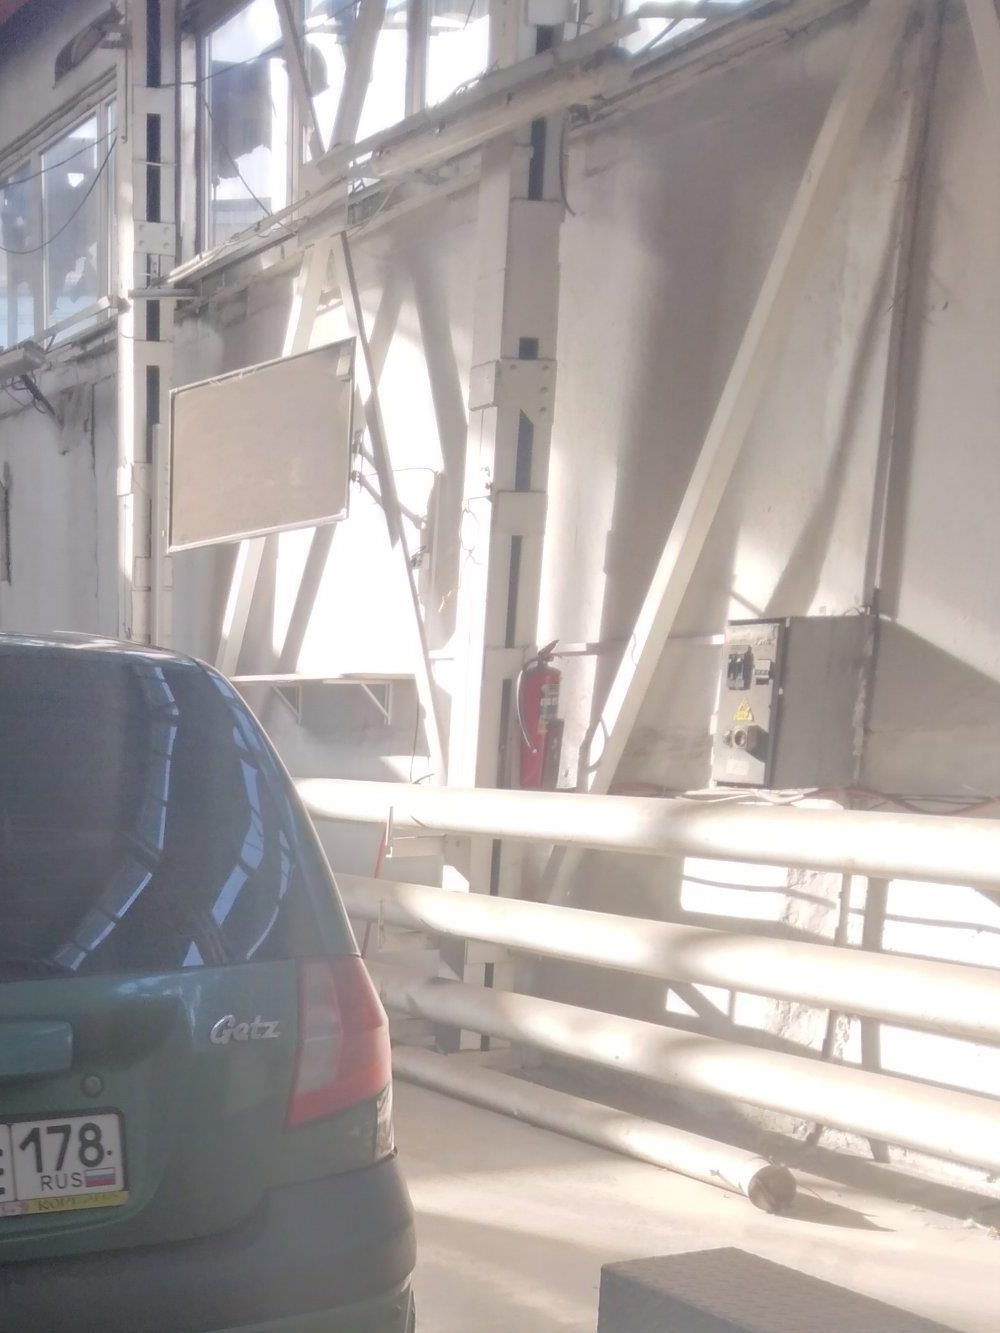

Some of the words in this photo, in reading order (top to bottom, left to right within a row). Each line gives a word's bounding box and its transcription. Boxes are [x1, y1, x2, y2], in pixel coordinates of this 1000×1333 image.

[210, 1014, 282, 1045] Getz
[20, 1123, 104, 1173] 178
[41, 1172, 83, 1191] RUS
